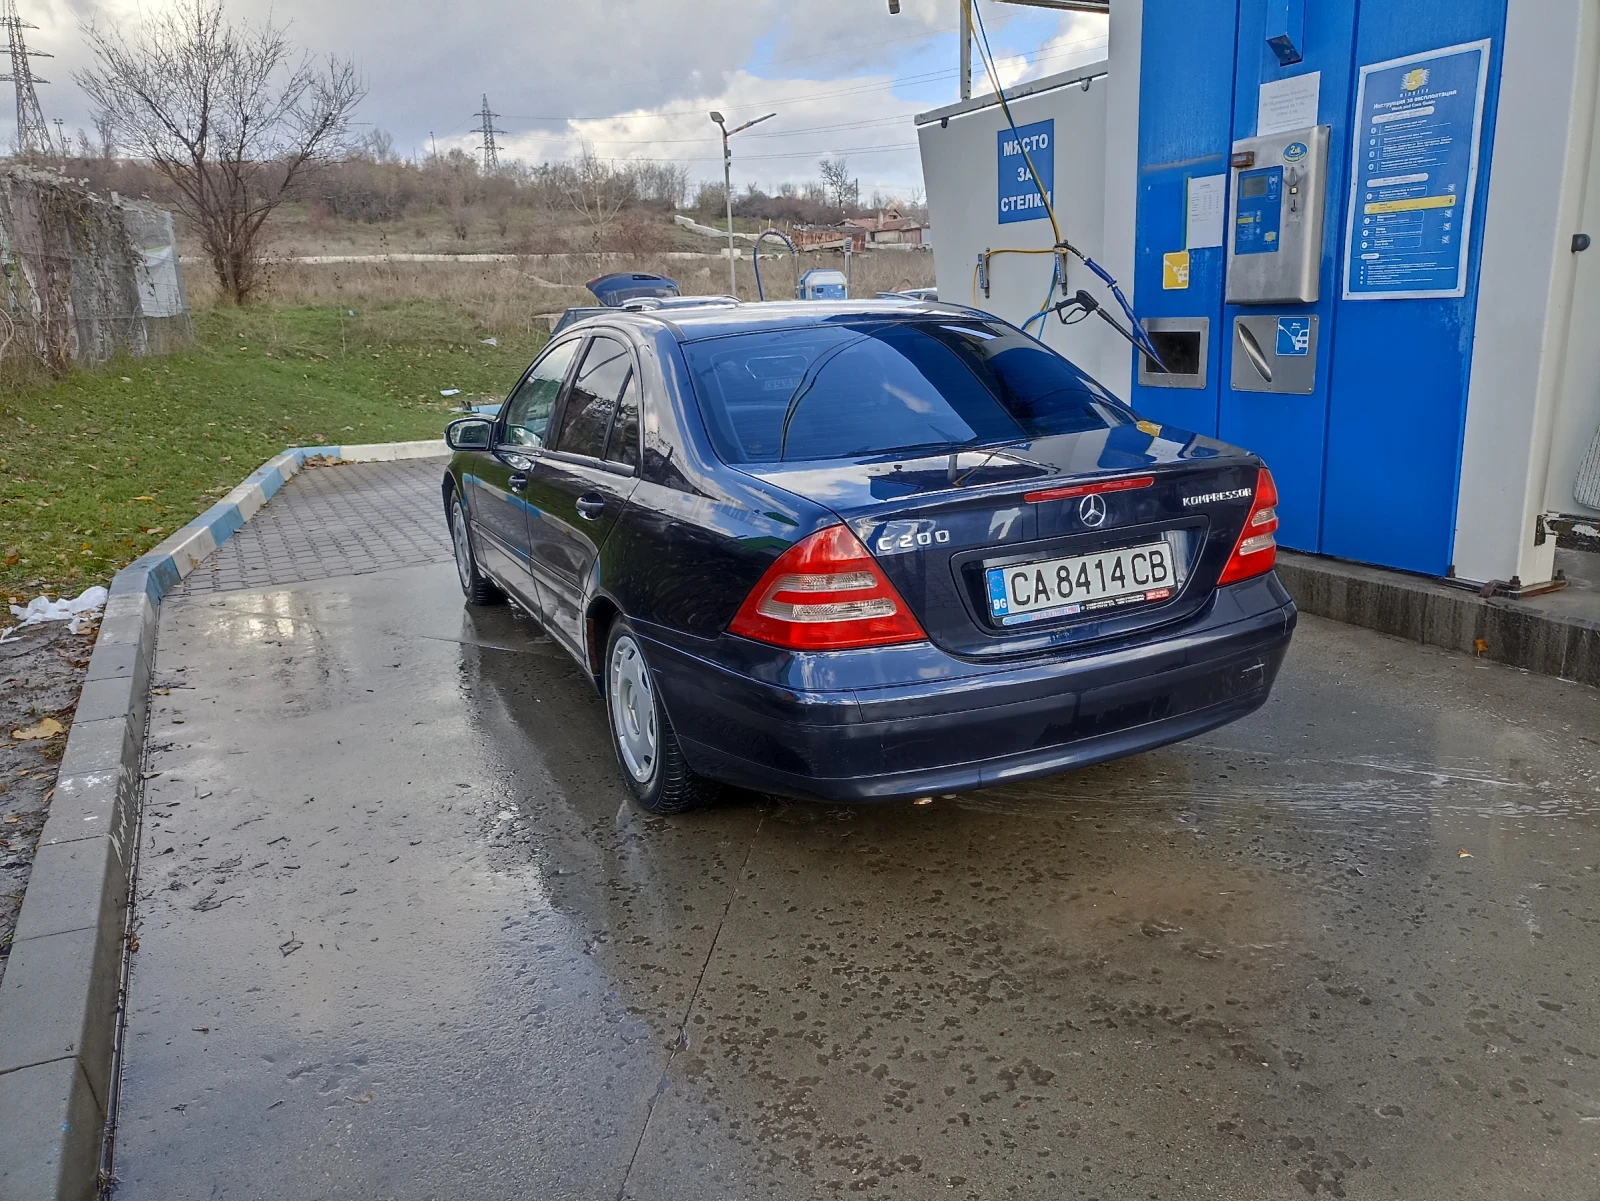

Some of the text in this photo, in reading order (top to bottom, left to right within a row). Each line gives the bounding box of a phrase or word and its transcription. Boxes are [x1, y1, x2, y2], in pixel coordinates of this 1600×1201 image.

[1003, 133, 1049, 157] МЯСТО
[1017, 166, 1034, 182] ЗА
[1182, 487, 1253, 507] KOMPRESSOR
[877, 530, 950, 551] C 200
[1010, 569, 1051, 606] CA
[1056, 556, 1126, 598] 8414
[1131, 550, 1168, 586] CB
[993, 598, 1007, 610] BG
